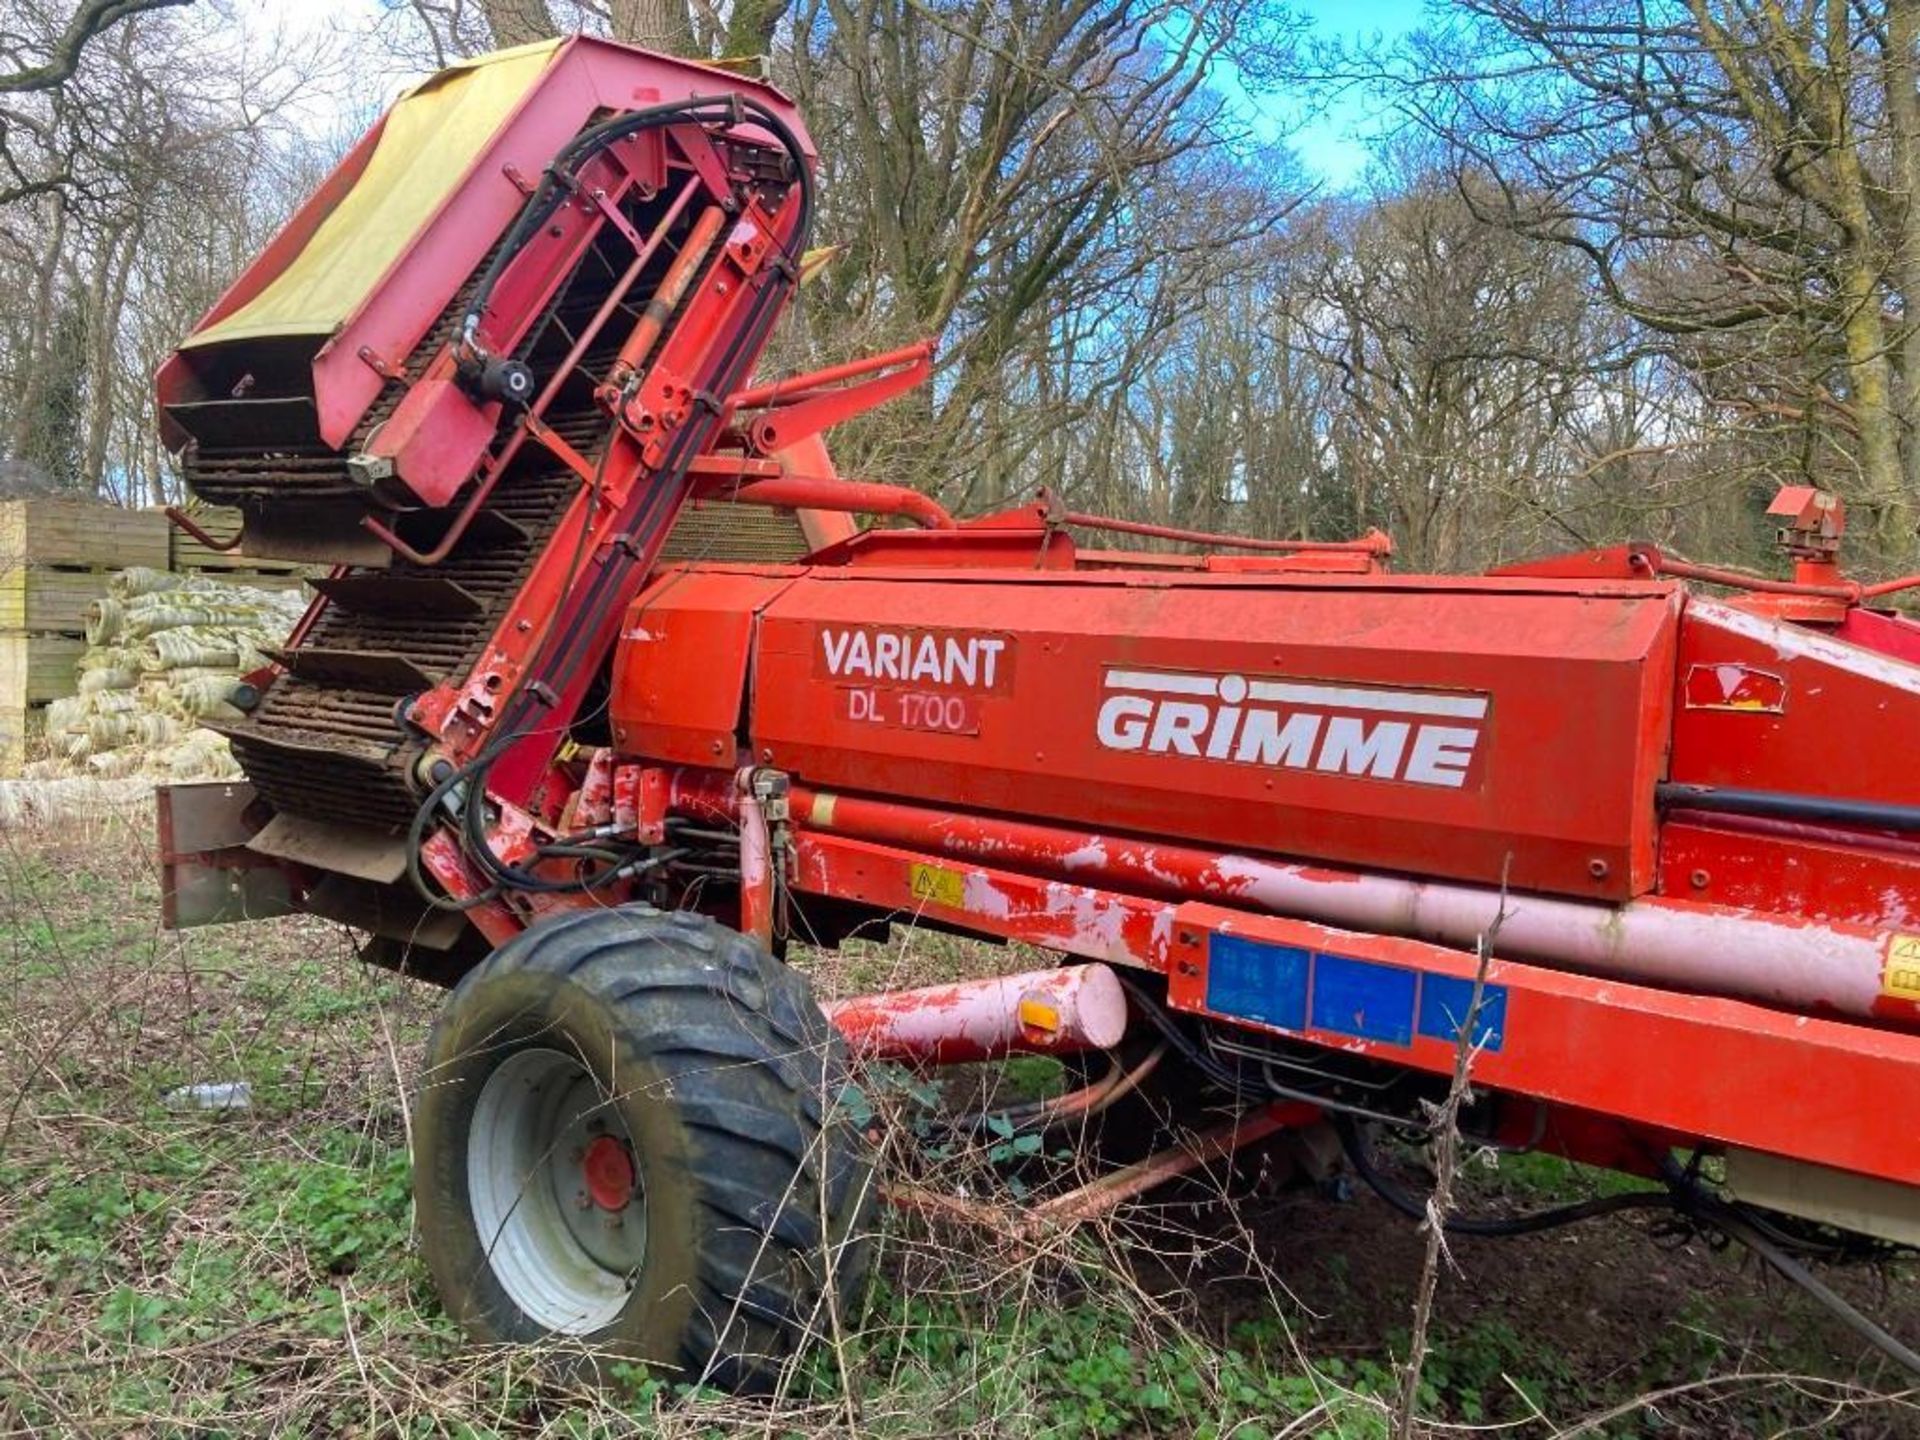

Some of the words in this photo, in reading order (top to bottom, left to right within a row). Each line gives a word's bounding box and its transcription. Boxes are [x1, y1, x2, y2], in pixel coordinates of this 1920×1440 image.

[822, 629, 1005, 688] VARIANT
[850, 690, 885, 722] DL
[899, 694, 966, 730] 1700
